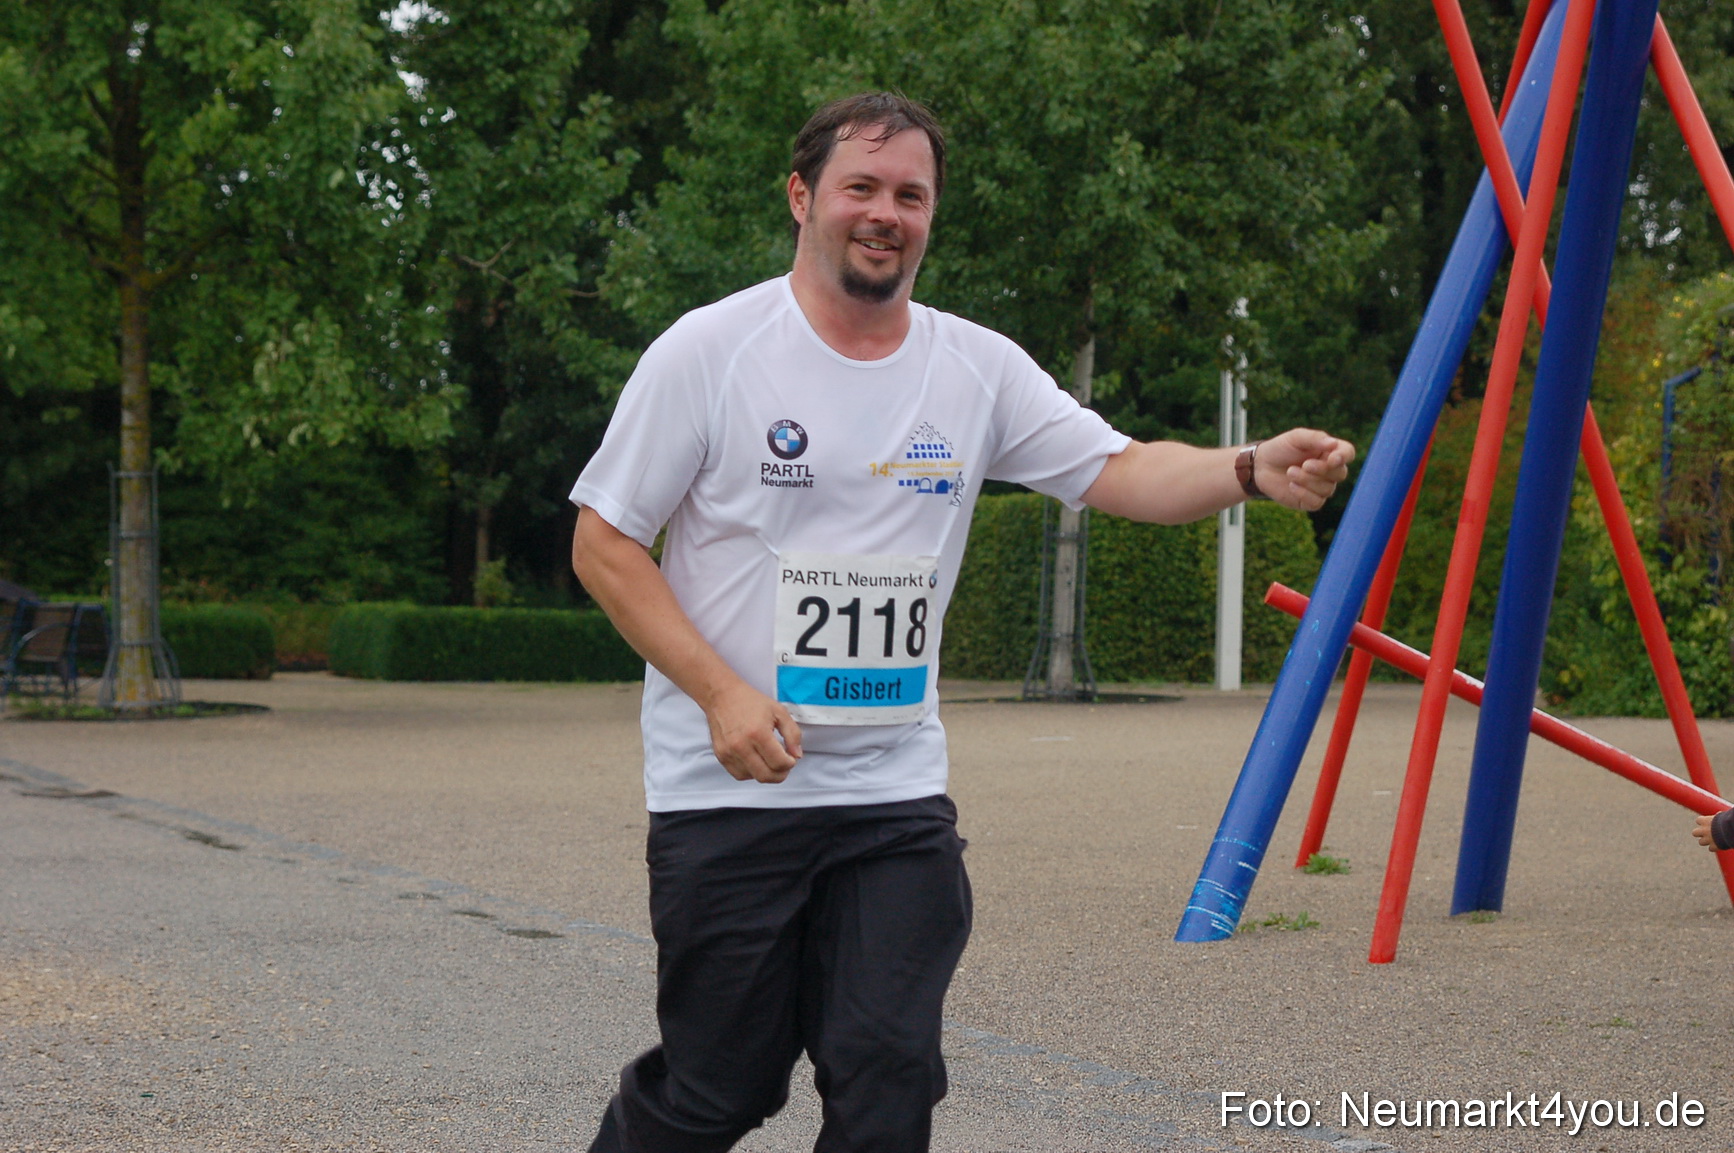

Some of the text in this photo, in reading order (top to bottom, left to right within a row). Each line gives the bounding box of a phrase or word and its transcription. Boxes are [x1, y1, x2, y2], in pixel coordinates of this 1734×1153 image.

[770, 420, 804, 435] BMW
[761, 462, 815, 478] PARTL
[869, 462, 894, 477] 14.
[761, 476, 814, 488] Neumarkt
[782, 569, 924, 588] PARTL Neumarkt
[795, 595, 928, 659] 2118
[781, 652, 788, 664] C
[825, 676, 903, 700] Gisbert
